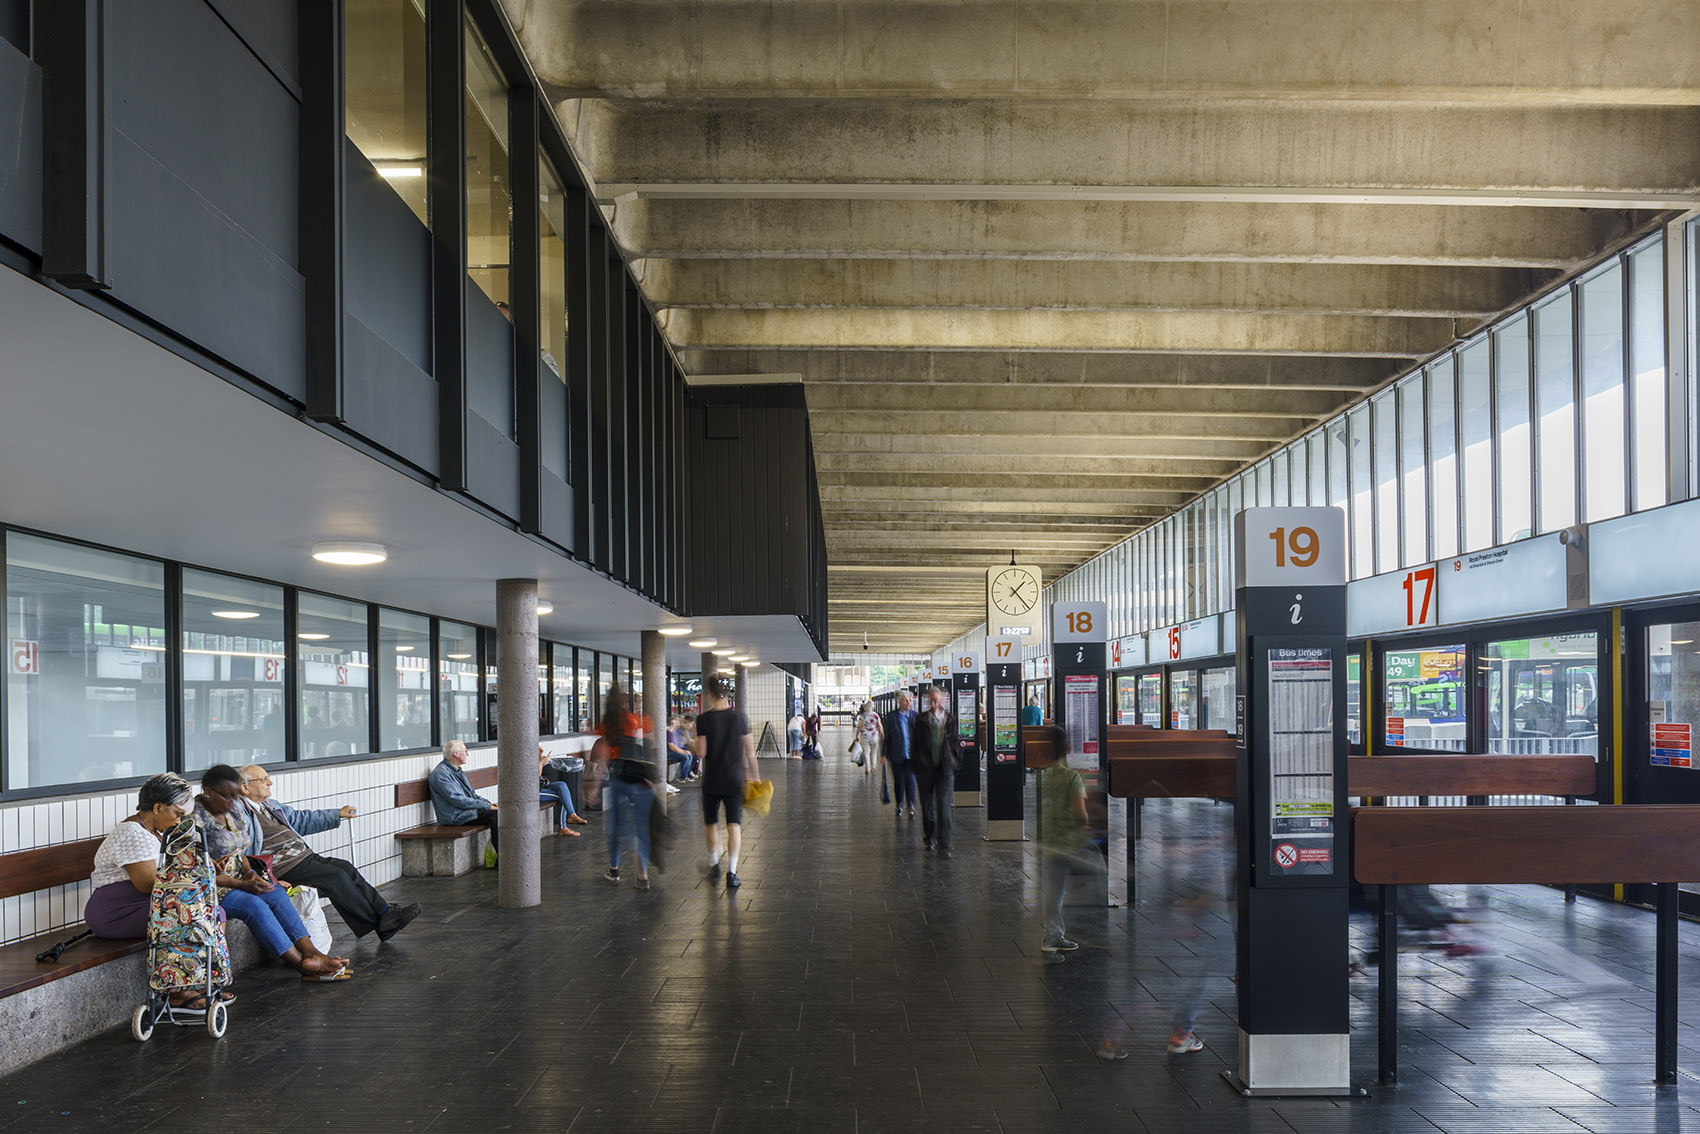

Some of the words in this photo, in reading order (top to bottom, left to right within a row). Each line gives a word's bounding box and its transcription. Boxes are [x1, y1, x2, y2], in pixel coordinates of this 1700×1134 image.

[1269, 526, 1320, 568] 19
[1453, 560, 1462, 572] 19
[1402, 566, 1435, 627] 17
[1065, 611, 1093, 634] 18
[995, 642, 1012, 657] 17
[1168, 627, 1180, 659] 15
[1111, 640, 1120, 667] 14
[1279, 649, 1297, 657] Bus
[1298, 649, 1323, 657] times
[958, 656, 973, 669] 16
[1391, 656, 1416, 667] Day
[922, 671, 932, 680] 14
[937, 665, 949, 676] 15
[1387, 667, 1403, 677] 49
